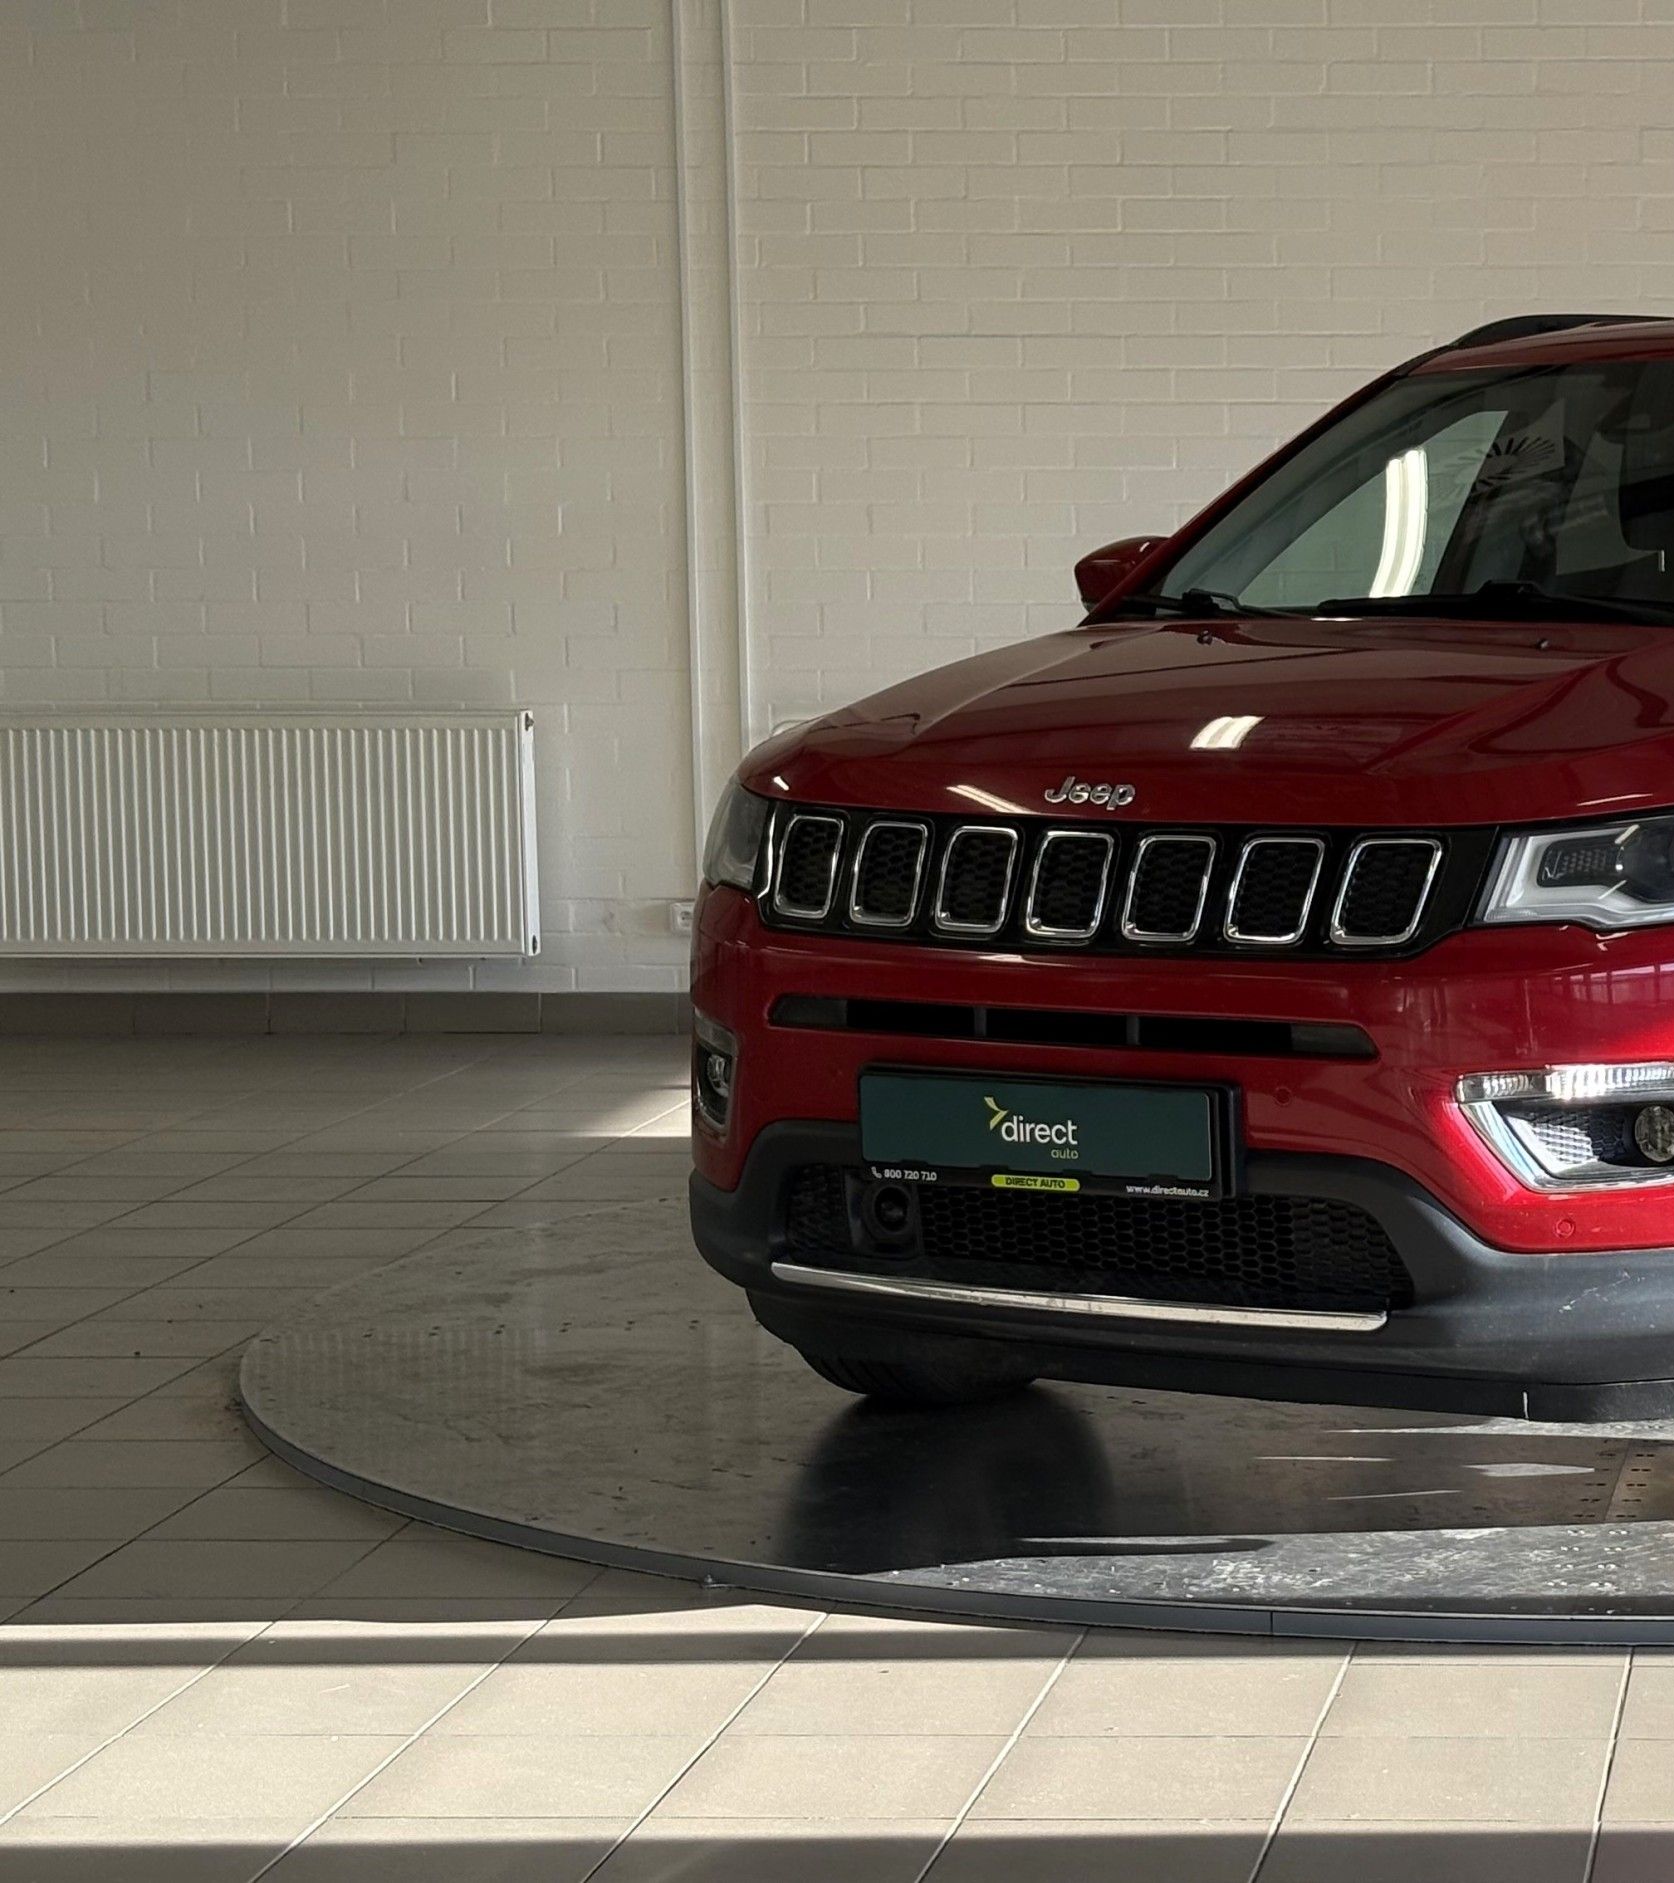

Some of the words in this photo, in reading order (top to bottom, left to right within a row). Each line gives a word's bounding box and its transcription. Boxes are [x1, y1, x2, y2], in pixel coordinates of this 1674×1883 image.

[1044, 776, 1136, 811] Jeep
[1001, 1115, 1078, 1145] direct
[1050, 1149, 1079, 1160] auto
[884, 1169, 902, 1179] 800
[920, 1171, 937, 1181] 710
[1005, 1177, 1038, 1187] DIRECT
[1040, 1179, 1066, 1189] AUTO
[1125, 1184, 1209, 1197] www.directauto.cz
